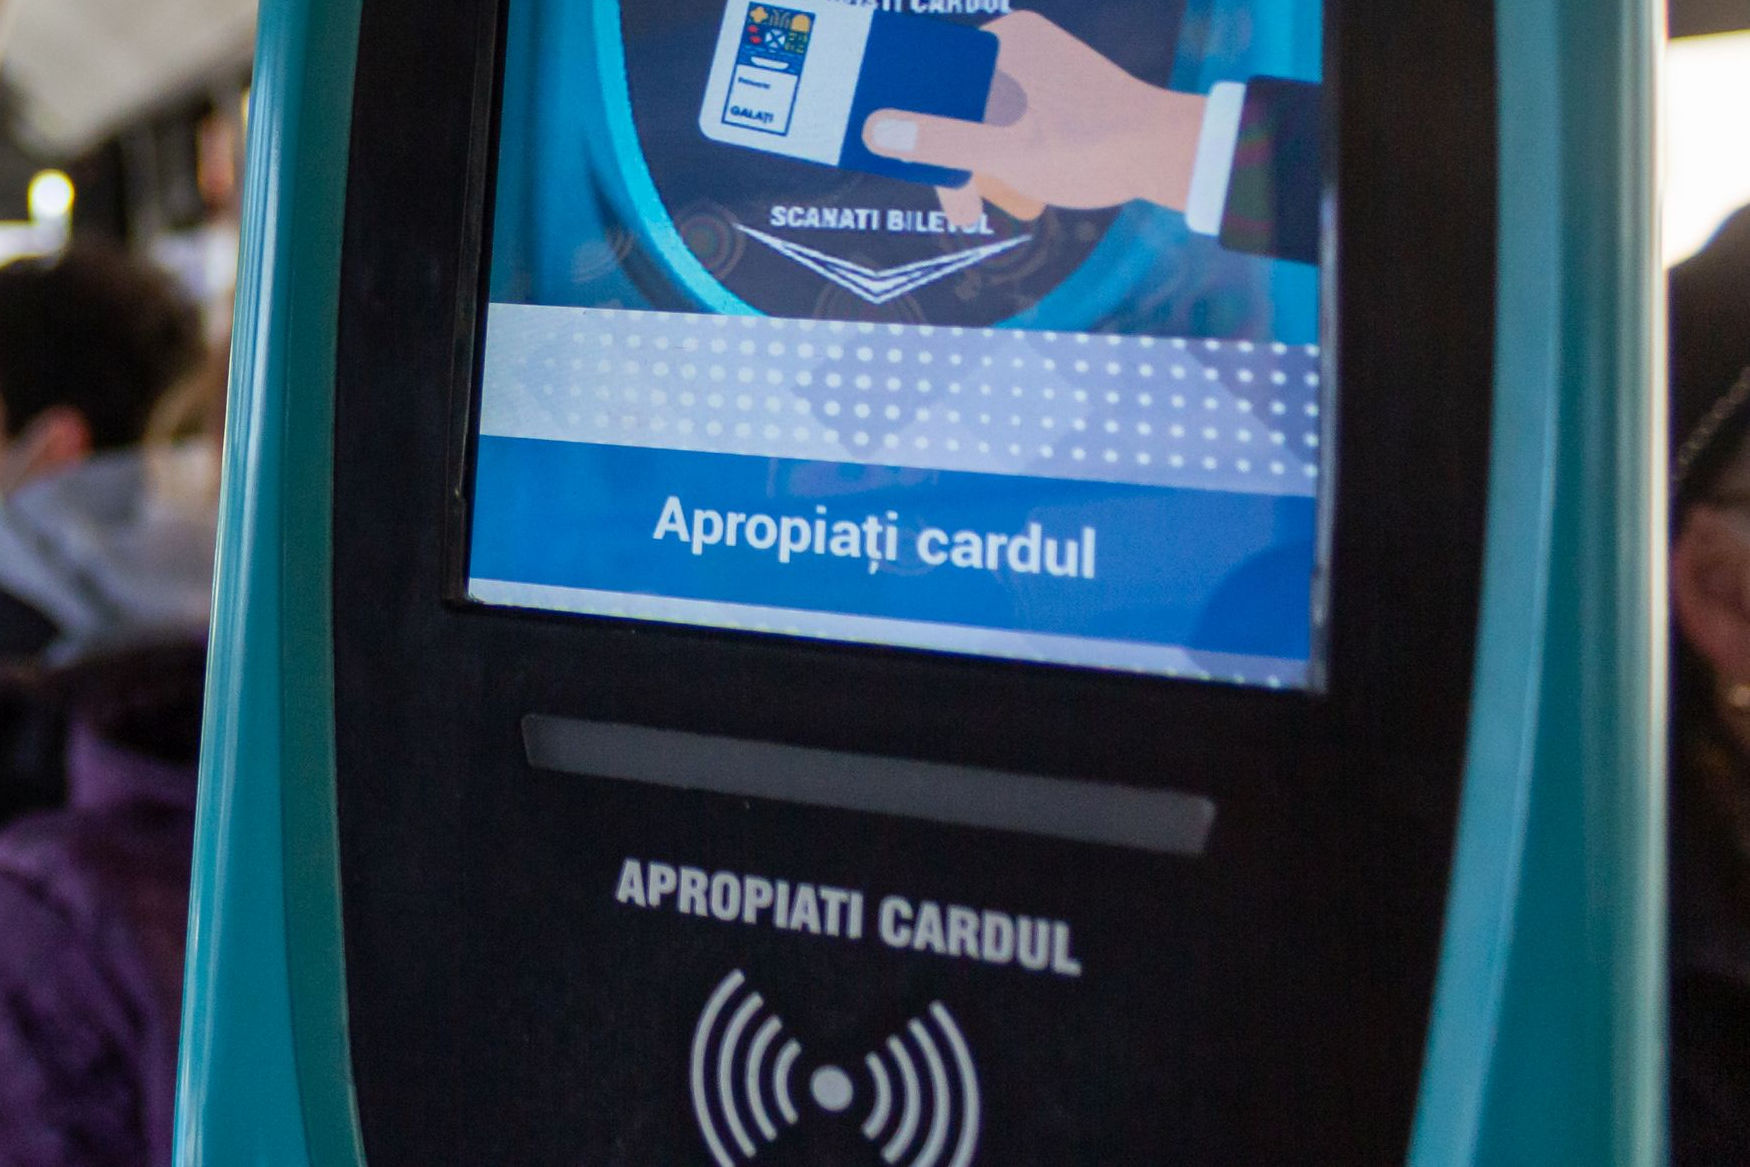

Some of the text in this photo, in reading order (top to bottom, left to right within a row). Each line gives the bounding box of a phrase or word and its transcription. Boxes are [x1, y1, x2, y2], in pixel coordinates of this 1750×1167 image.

[770, 205, 994, 234] SCANATI BILEL
[653, 495, 1096, 579] Apropiați cardul
[615, 859, 1081, 977] APROPIATI CARDUL
